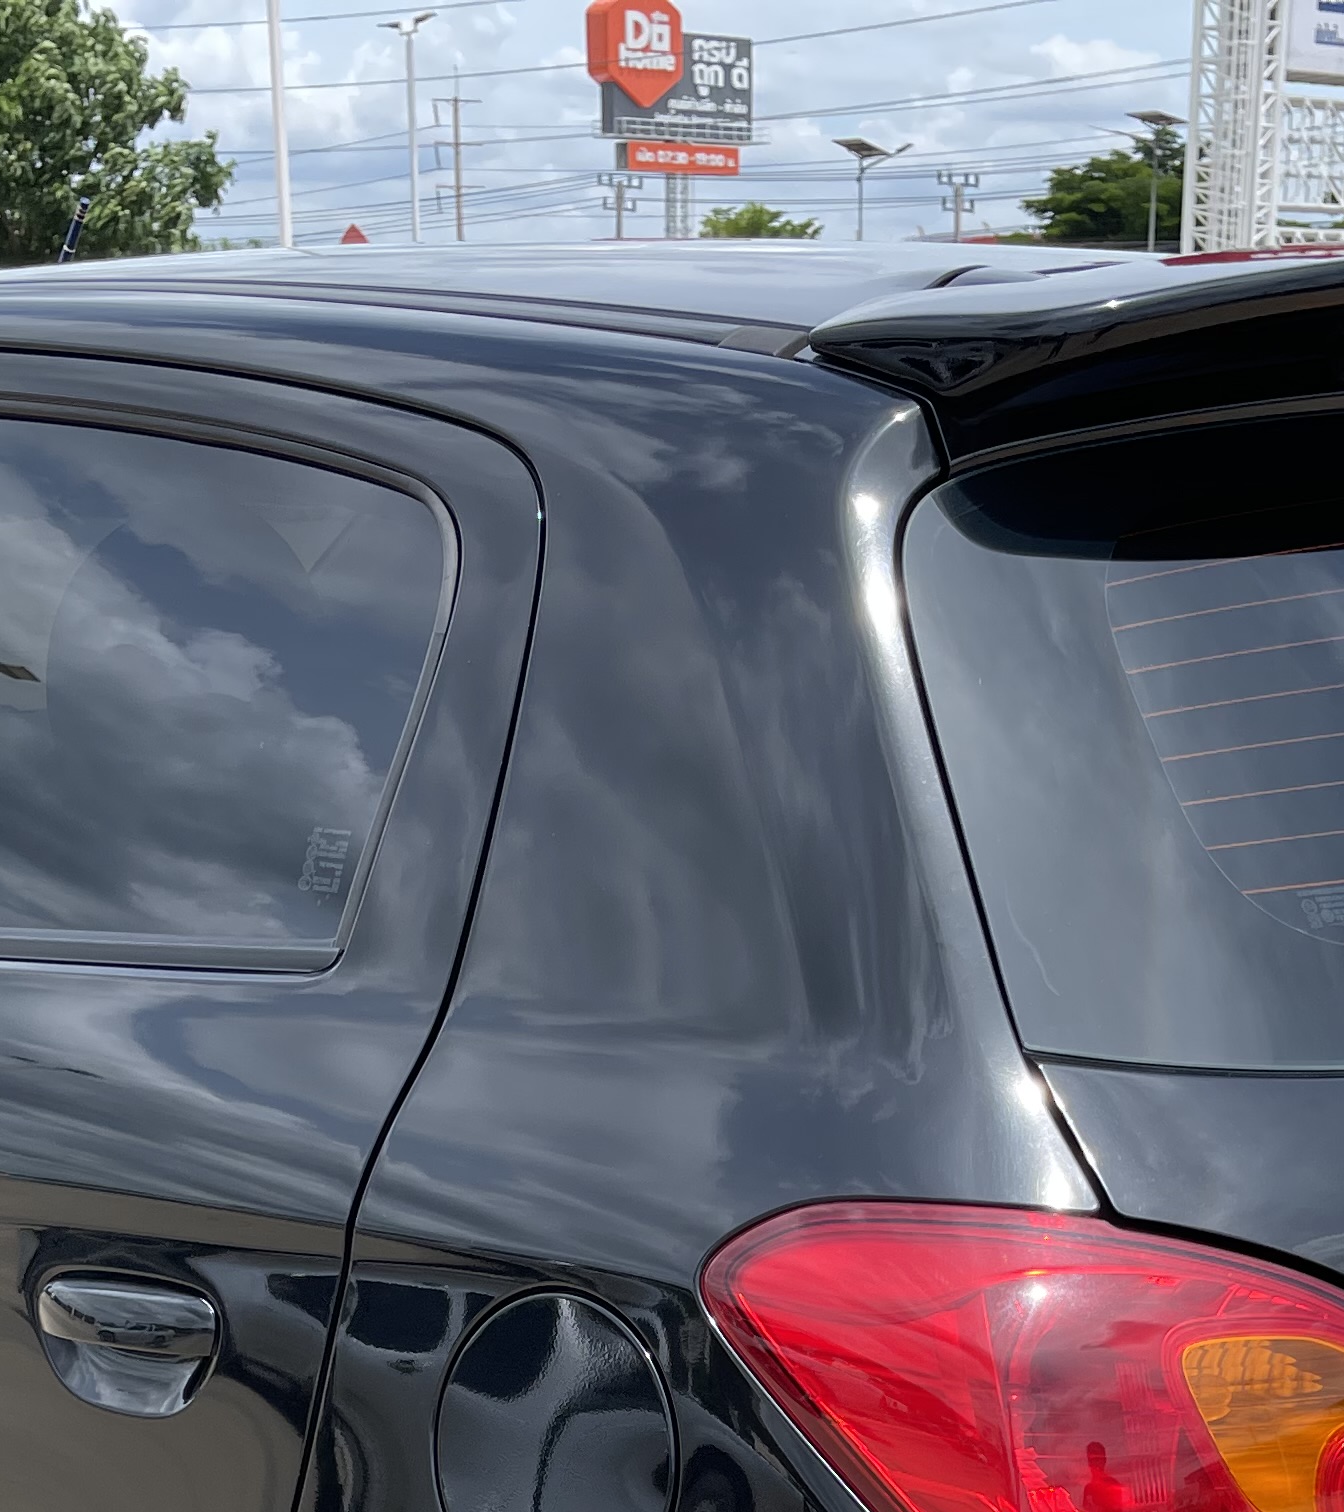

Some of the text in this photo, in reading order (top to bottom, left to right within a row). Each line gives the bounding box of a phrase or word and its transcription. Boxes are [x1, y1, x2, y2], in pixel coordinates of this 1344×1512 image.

[618, 43, 676, 72] home
[691, 38, 737, 64] ครบ
[691, 57, 750, 97] ถูก ดี
